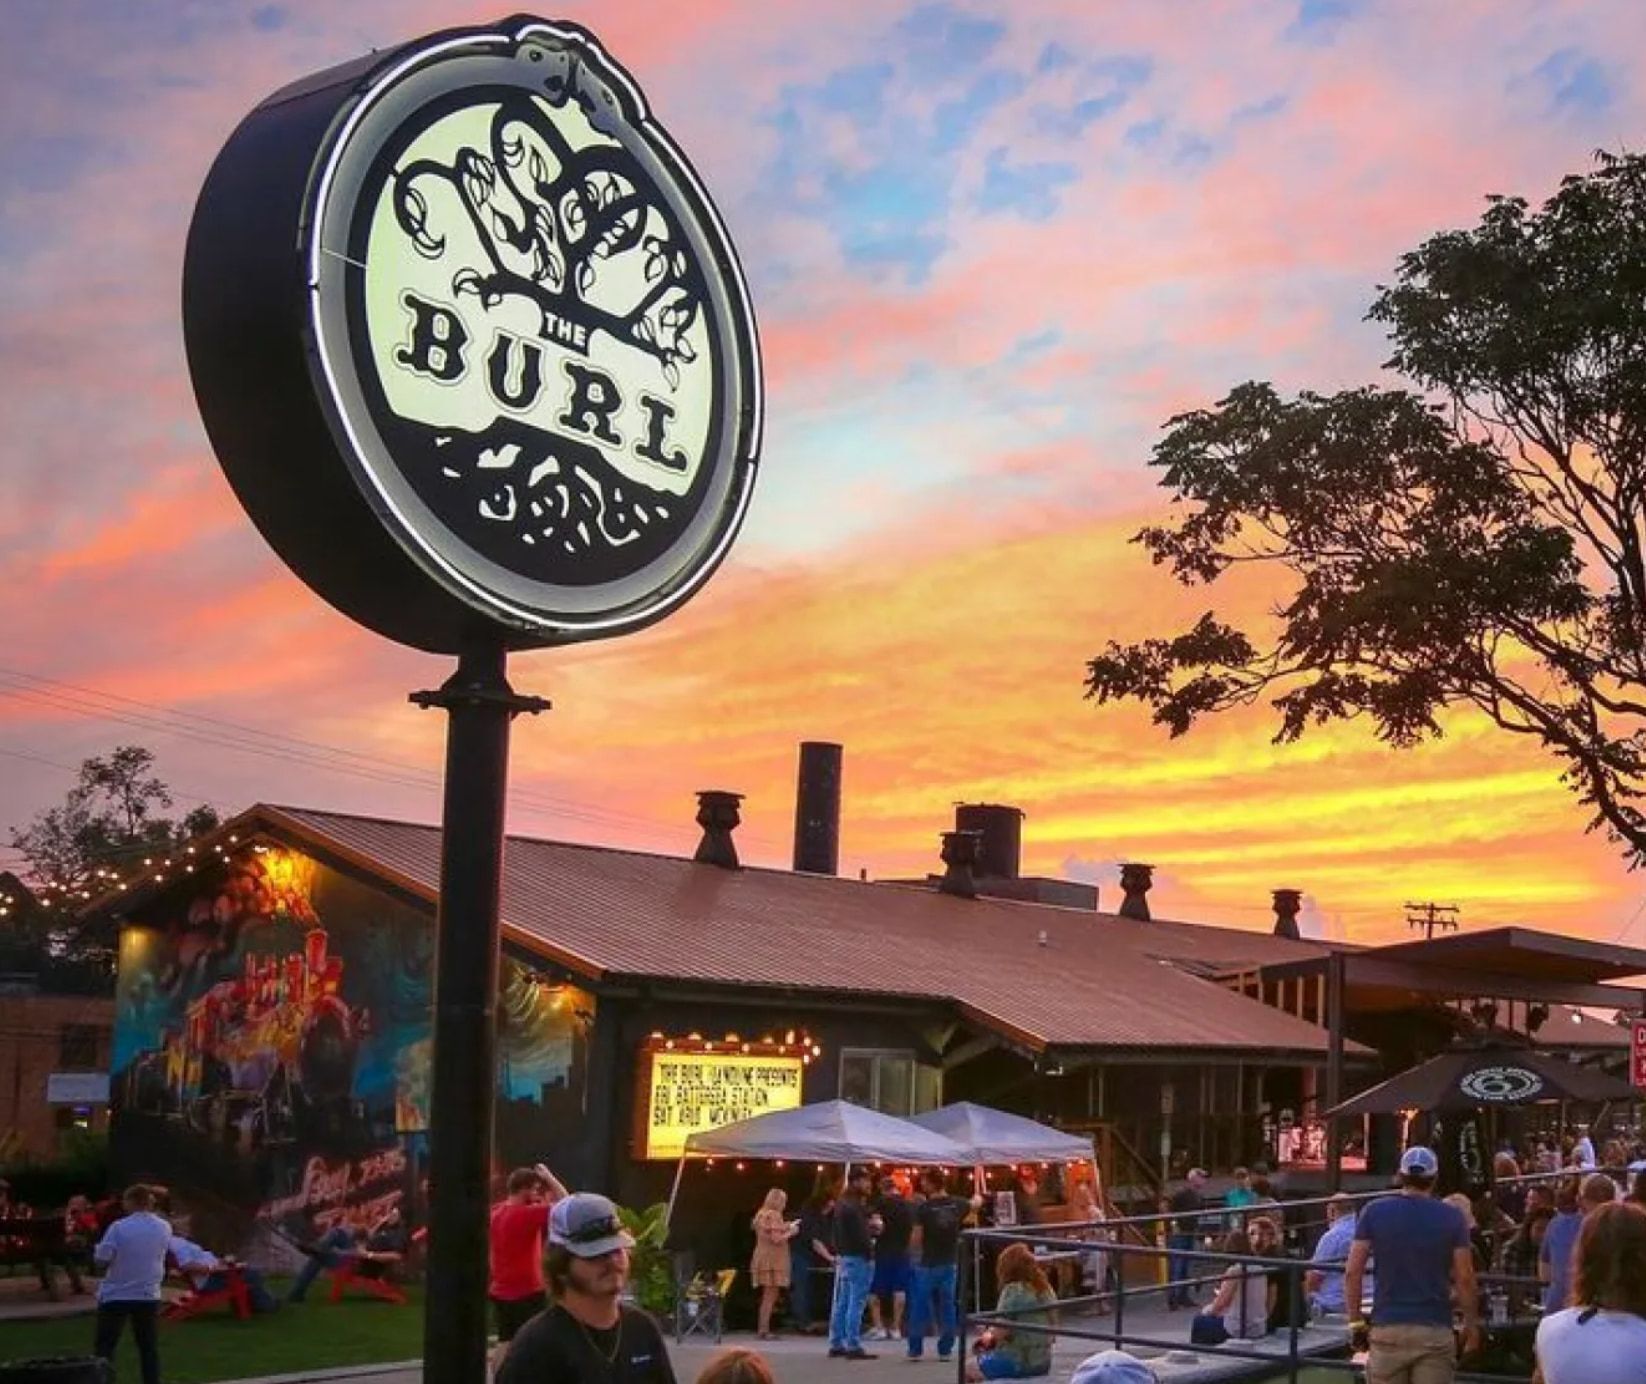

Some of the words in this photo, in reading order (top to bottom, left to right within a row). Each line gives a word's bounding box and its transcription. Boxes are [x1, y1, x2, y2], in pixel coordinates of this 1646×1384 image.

[544, 311, 587, 345] THE
[397, 294, 688, 471] BURL
[757, 1066, 798, 1088] PRESENTS
